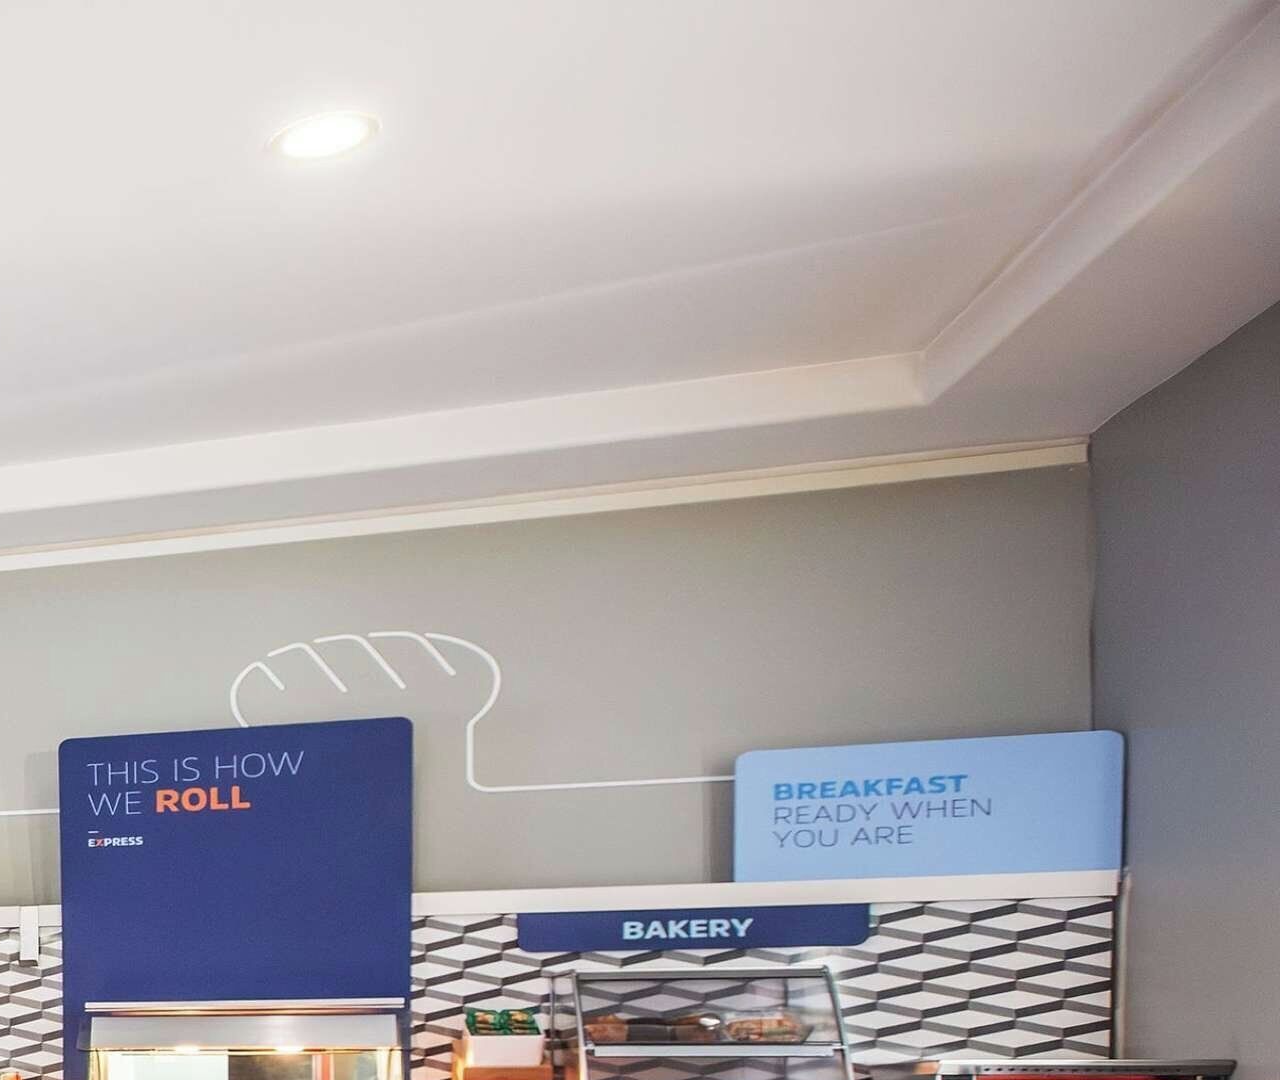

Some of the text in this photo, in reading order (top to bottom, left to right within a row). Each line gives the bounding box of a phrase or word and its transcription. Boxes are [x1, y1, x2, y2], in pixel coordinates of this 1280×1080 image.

[86, 750, 305, 786] THIS IS HOW
[87, 784, 252, 816] WE ROLL
[773, 773, 968, 801] BREAKFAST
[773, 797, 993, 826] READY WHEN
[87, 835, 144, 848] EXPRESS
[772, 824, 914, 849] YOU ARE
[622, 918, 754, 941] BAKERY
